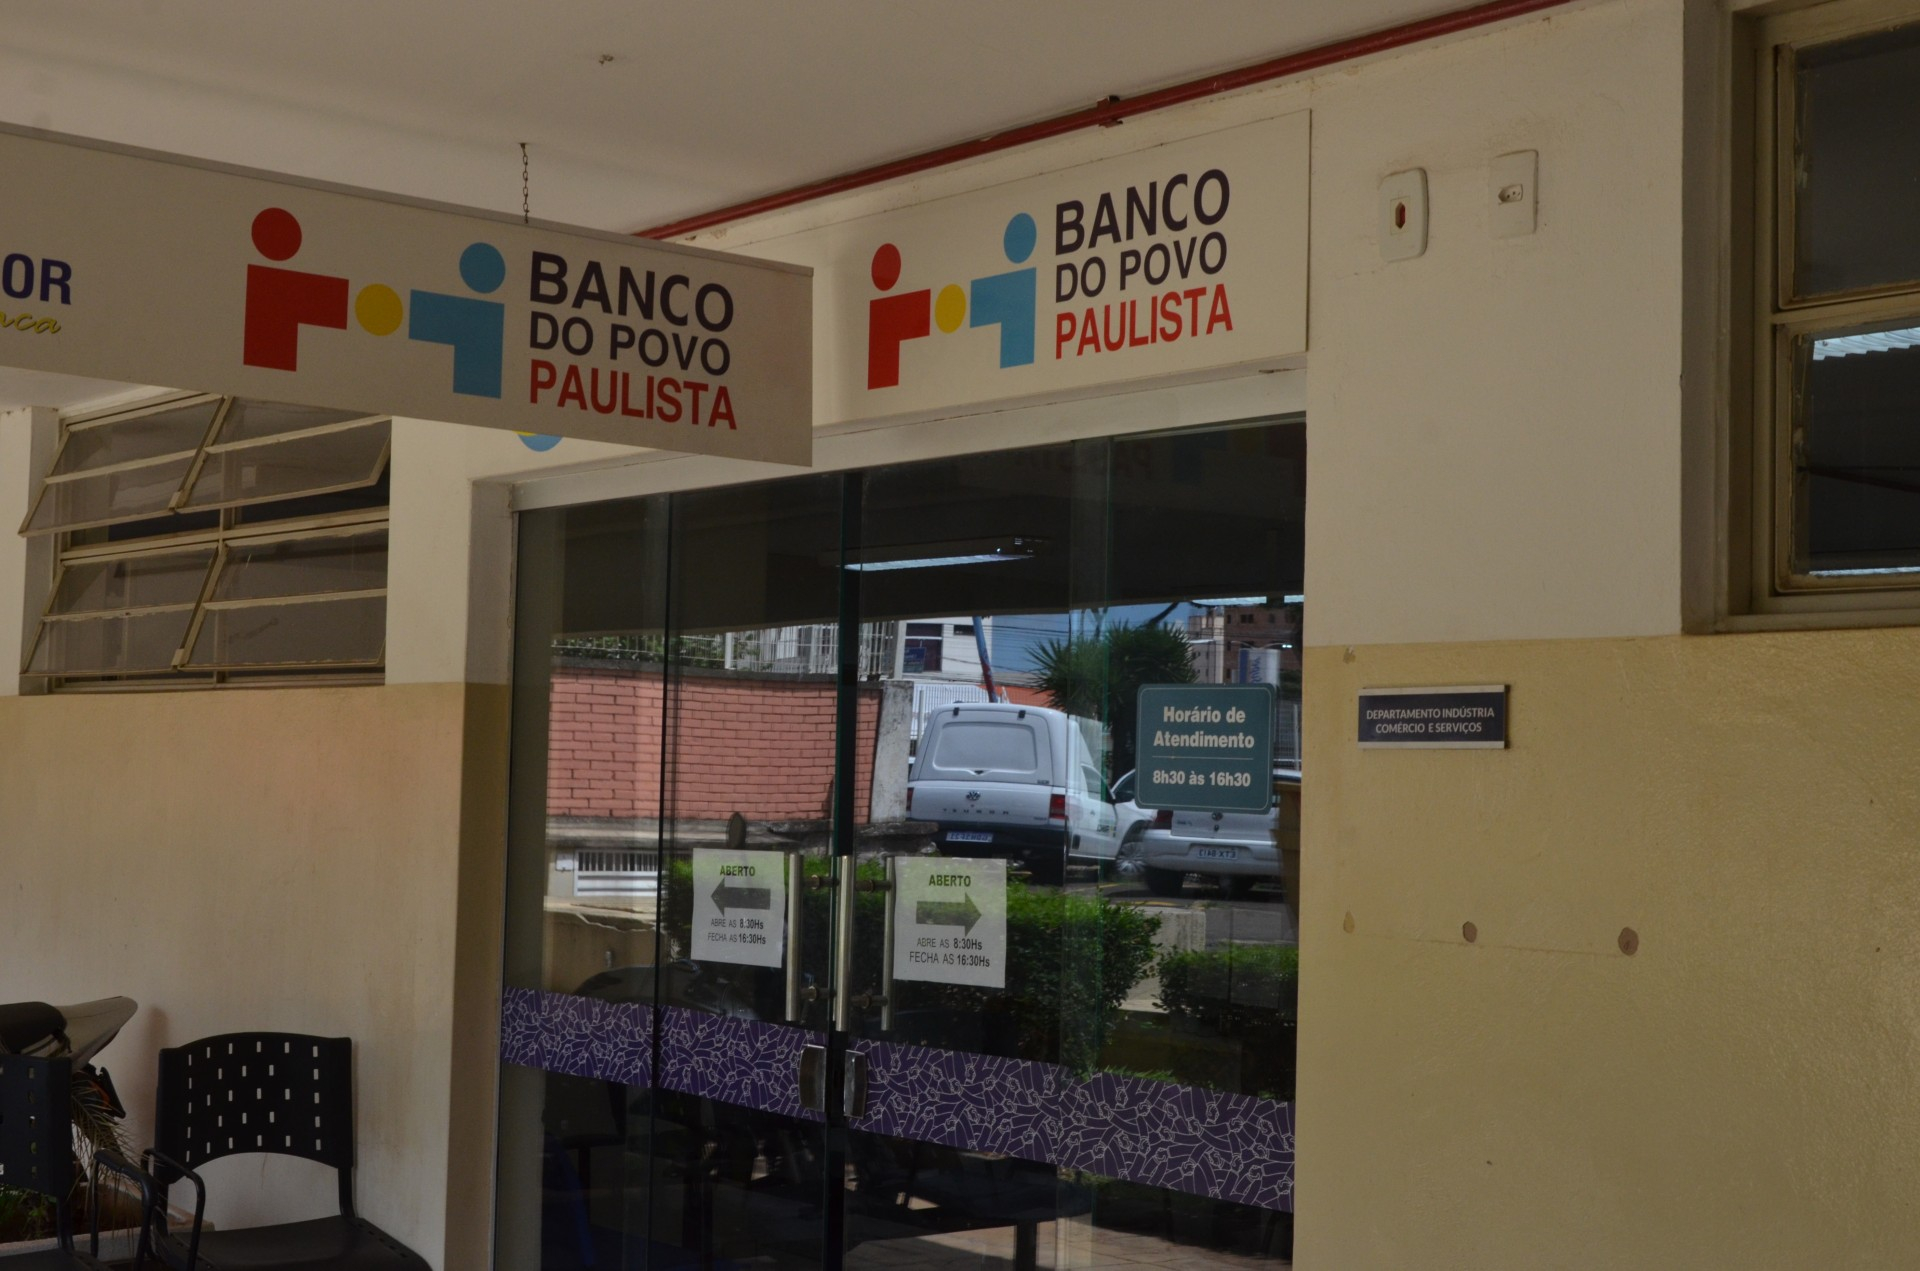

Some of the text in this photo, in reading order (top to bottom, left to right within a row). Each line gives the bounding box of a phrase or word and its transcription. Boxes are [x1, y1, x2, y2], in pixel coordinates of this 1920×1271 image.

[1055, 168, 1230, 256] BANCO
[1055, 231, 1228, 304] DO POVO
[529, 250, 734, 333] BANCO
[1055, 283, 1234, 360] PAULISTA
[529, 310, 731, 376] DO POVO
[529, 358, 737, 430] PAULISTA
[1163, 705, 1246, 724] Horário de
[1366, 705, 1495, 720] DEPARTAMENTO INDÚSTRIA
[1375, 721, 1482, 735] COMÉRCIO E SERVIÇOS
[1153, 730, 1255, 750] Atendimento
[1152, 769, 1251, 788] 8h30 às 16h30
[720, 865, 756, 876] ABERTO
[929, 874, 971, 887] ABERTO
[711, 918, 726, 927] ABRE
[708, 933, 727, 942] FECHA
[739, 933, 766, 944] 16:30Hs
[917, 938, 983, 950] ABRE AS 8:30Hs
[909, 951, 990, 967] FECHA AS 16:30Hs
